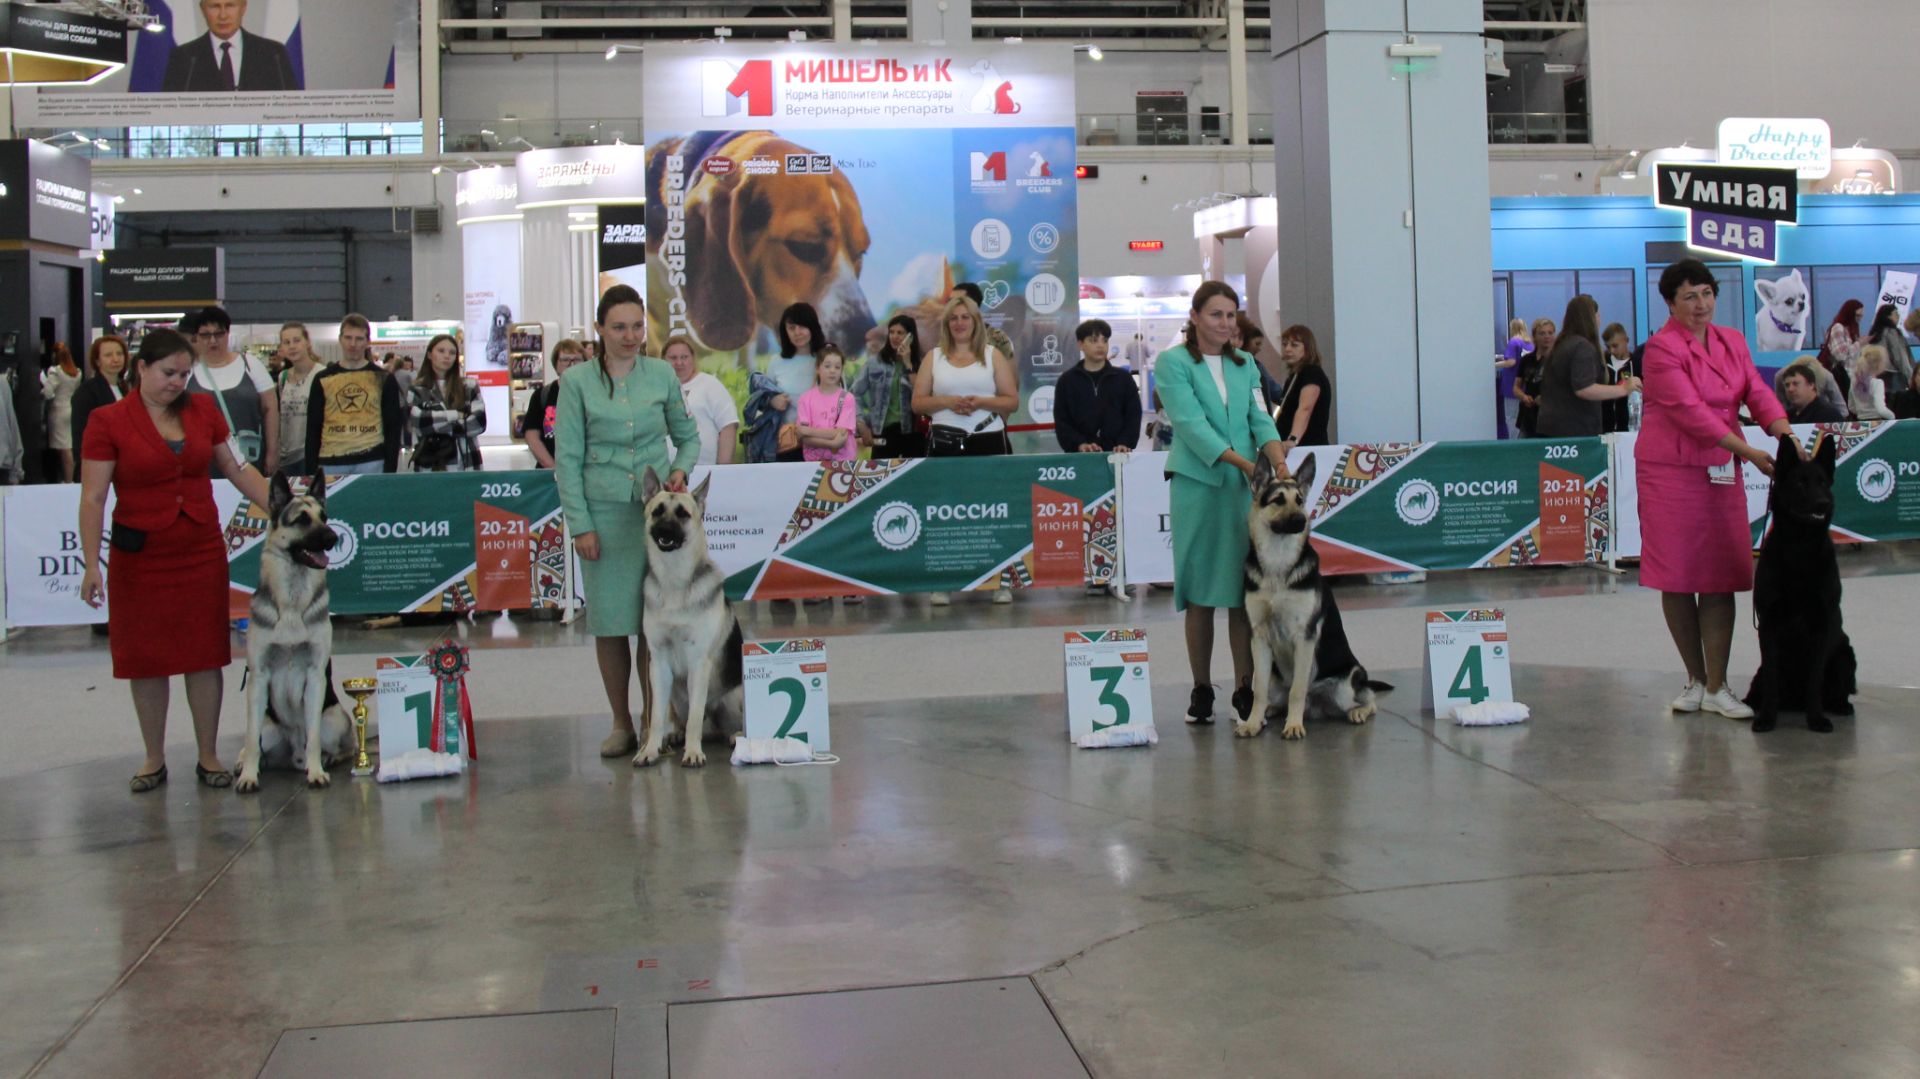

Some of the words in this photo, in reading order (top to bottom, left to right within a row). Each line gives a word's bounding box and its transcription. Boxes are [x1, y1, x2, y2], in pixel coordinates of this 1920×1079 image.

[53, 22, 68, 31] ДЛЯ
[785, 58, 908, 83] МИШЕЛЬ
[785, 89, 819, 102] Корма
[822, 88, 889, 100] Наполнители
[892, 88, 953, 102] Аксессуары
[785, 103, 881, 117] Ветеринарные
[884, 102, 954, 117] препараты
[1748, 123, 1824, 149] Happy
[1728, 144, 1821, 162] Breeder
[537, 161, 616, 179] ЗАРЯЖЕНЫ
[1669, 171, 1787, 211] Умная
[1701, 219, 1765, 249] еда
[1132, 241, 1161, 249] ТУАЛЕТ
[1545, 446, 1578, 458] 2026
[1038, 467, 1076, 480] 2026
[481, 483, 522, 497] 2026
[1444, 480, 1518, 497] РОССИЯ
[1543, 479, 1580, 493] 20-21
[1545, 497, 1580, 506] ИЮНЯ
[926, 503, 1008, 520] РОССИЯ
[1037, 503, 1078, 517] 20-21
[363, 520, 450, 539] РОССИЯ
[480, 520, 525, 535] 20-21
[1039, 521, 1079, 531] ИЮНЯ
[483, 540, 525, 549] ИЮНЯ
[1448, 645, 1489, 704] 4
[1090, 666, 1131, 733] 3
[768, 677, 808, 744] 2
[404, 691, 432, 749] 1
